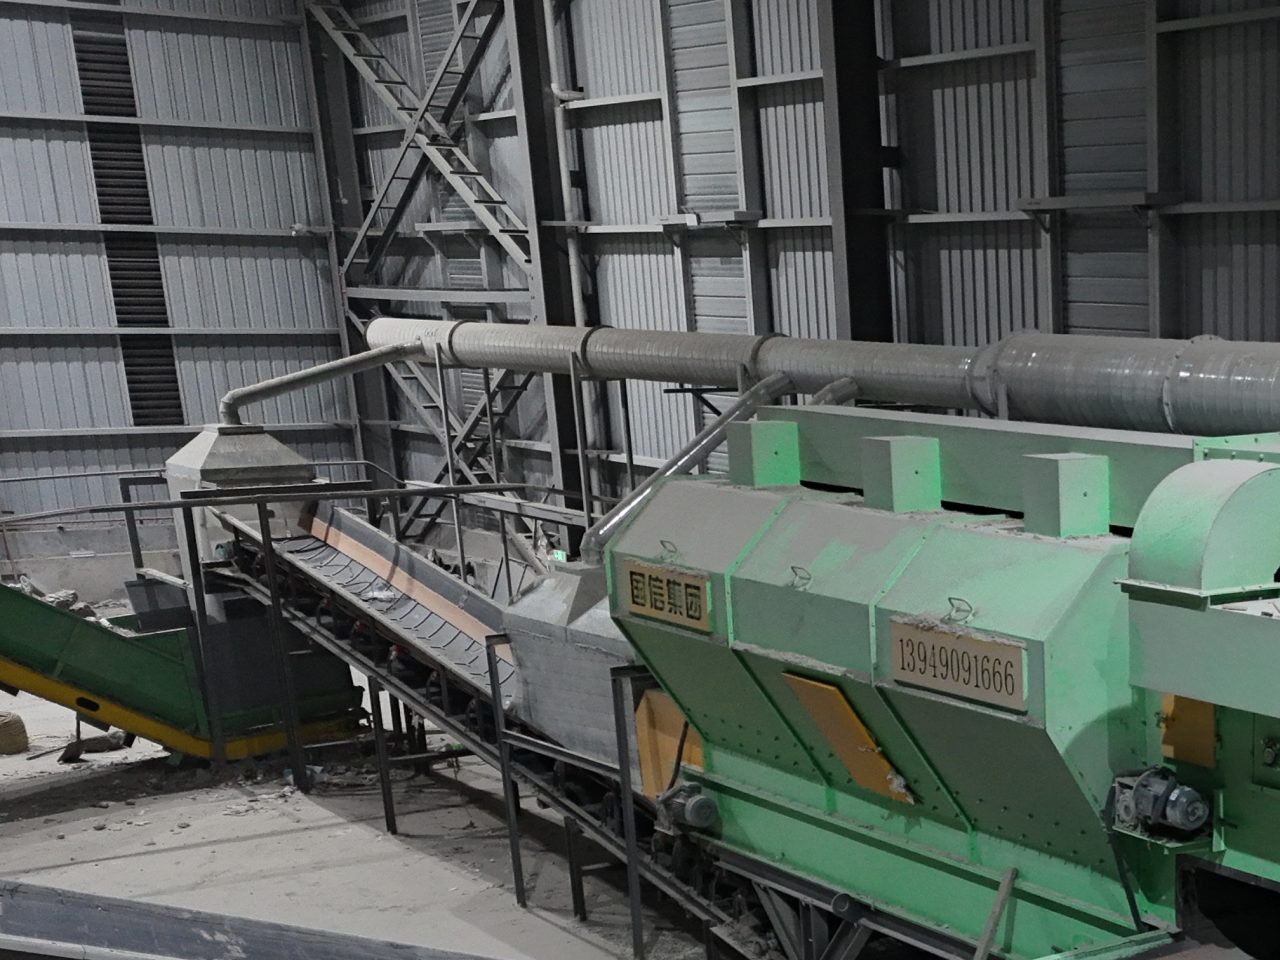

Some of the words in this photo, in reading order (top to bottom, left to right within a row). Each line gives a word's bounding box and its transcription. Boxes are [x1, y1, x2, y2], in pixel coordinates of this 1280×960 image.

[630, 571, 702, 621] 国信集团
[899, 638, 1015, 696] 13949091666
